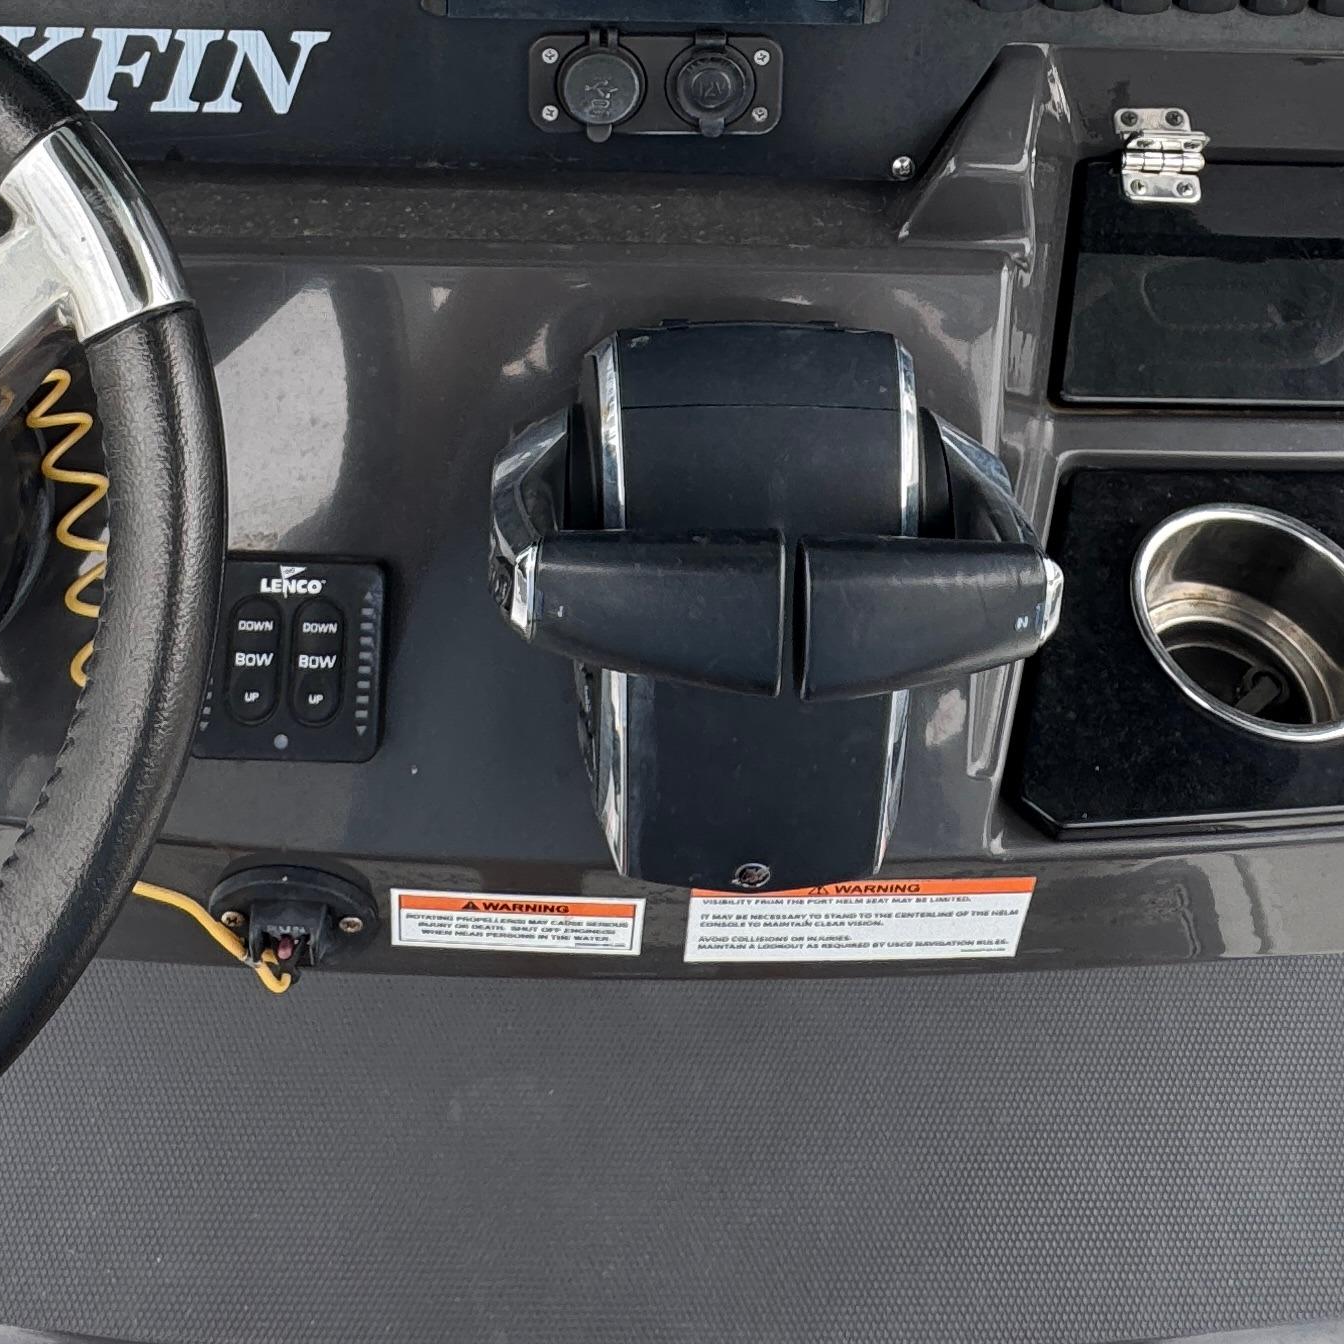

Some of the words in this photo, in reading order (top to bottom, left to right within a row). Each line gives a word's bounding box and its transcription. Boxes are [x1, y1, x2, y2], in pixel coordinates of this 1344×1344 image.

[260, 577, 323, 598] LENCO
[238, 620, 274, 631] DOWN
[302, 622, 338, 634] DOWN
[235, 652, 274, 667] BOW
[298, 654, 337, 669] BOW
[245, 692, 259, 702] UP
[308, 694, 323, 704] UP
[835, 883, 921, 895] WARNING
[482, 901, 570, 914] WARNING
